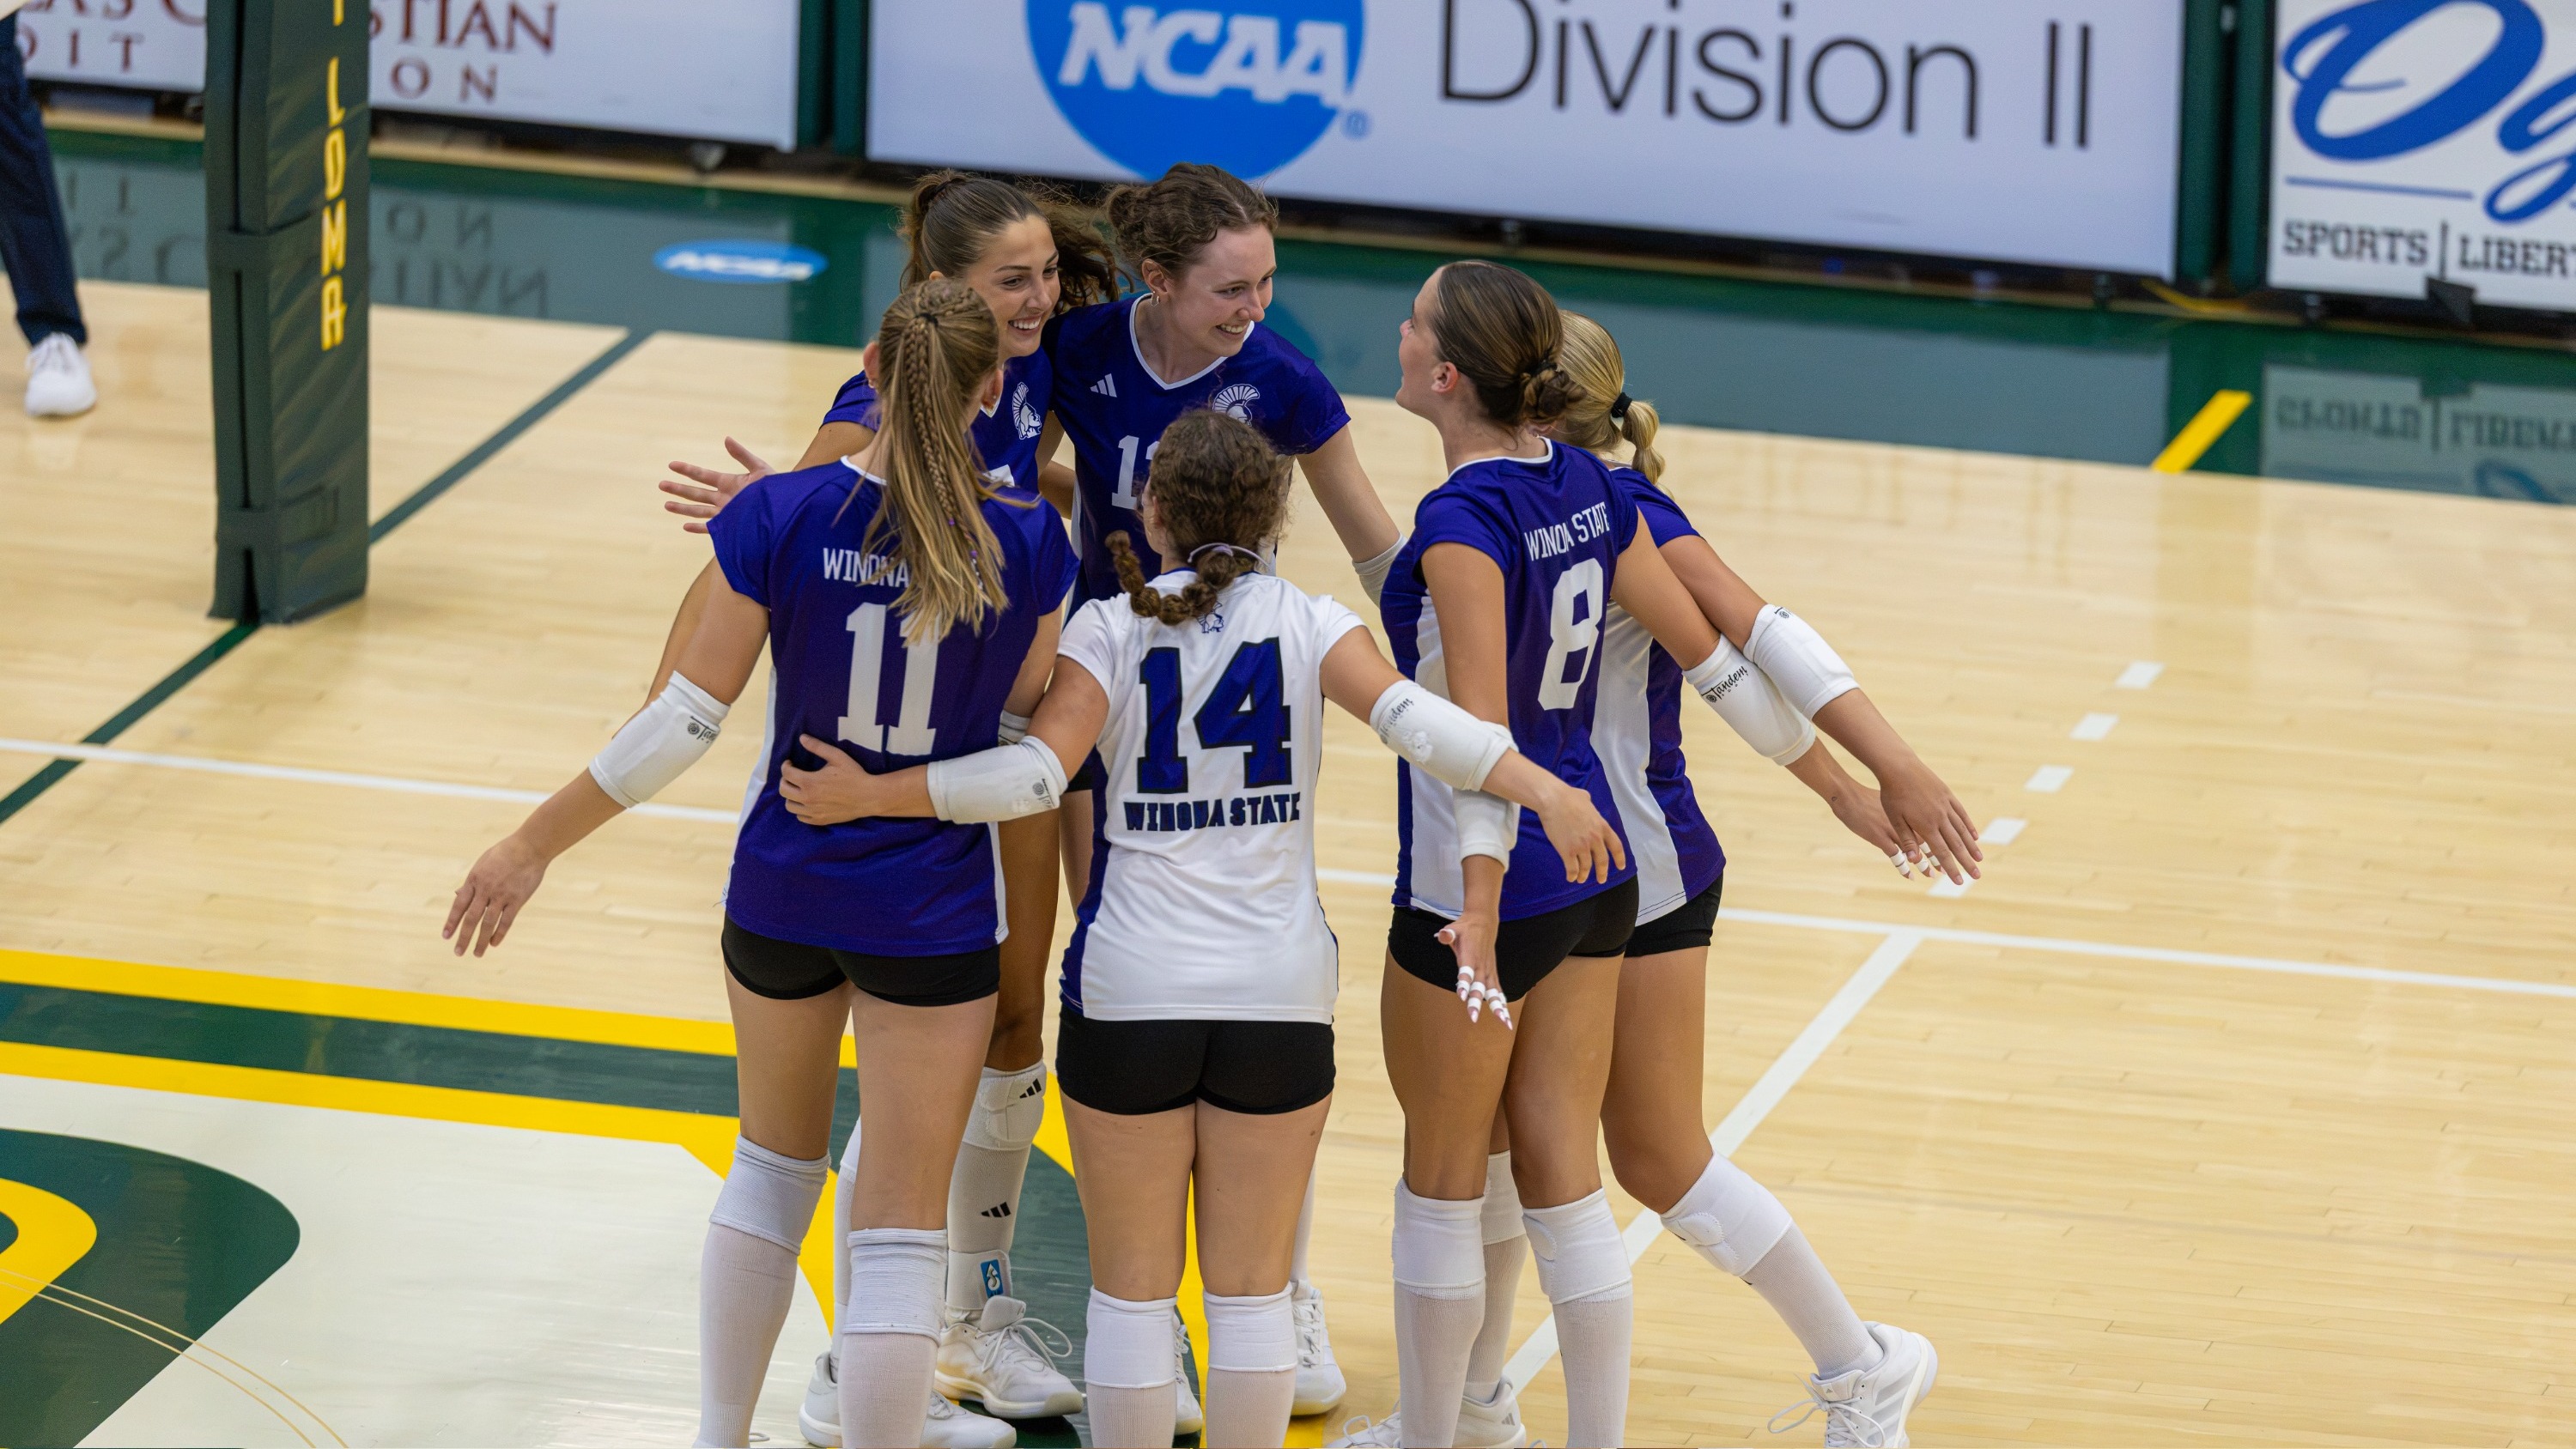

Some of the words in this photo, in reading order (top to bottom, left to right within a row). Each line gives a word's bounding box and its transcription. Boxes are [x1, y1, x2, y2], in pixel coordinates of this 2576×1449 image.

[1058, 2, 1360, 109] NCAA
[1439, 0, 1978, 140] Division
[321, 56, 347, 351] LOMA
[2283, 220, 2428, 266] SPORTS
[837, 602, 940, 756] 11
[1538, 558, 1604, 711] 8
[1701, 665, 1749, 700] Tandem
[1137, 636, 1291, 794] 14
[1230, 791, 1301, 827] STATE
